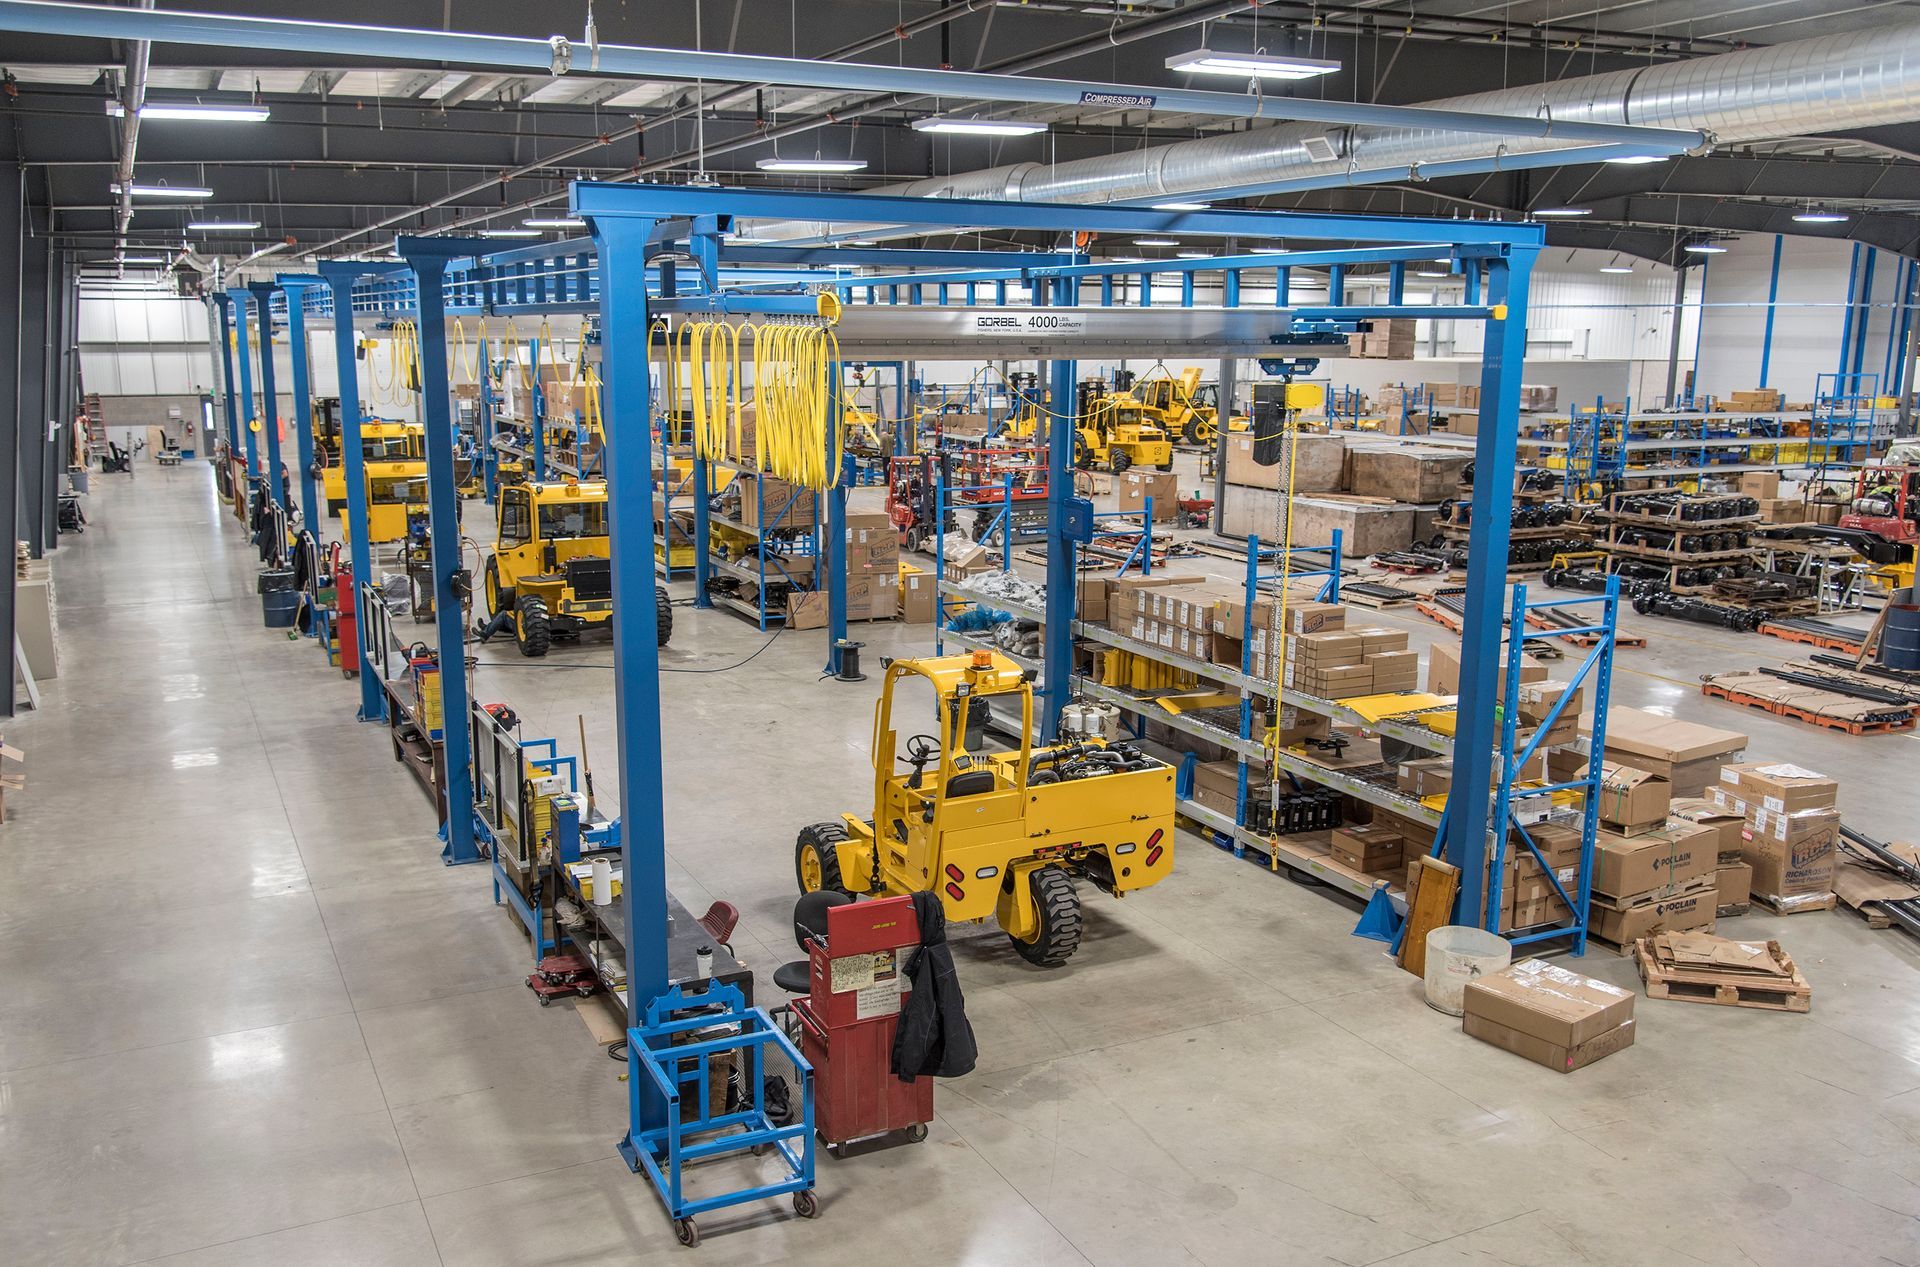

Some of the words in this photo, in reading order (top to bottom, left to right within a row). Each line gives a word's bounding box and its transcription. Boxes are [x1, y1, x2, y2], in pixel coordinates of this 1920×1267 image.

[1084, 93, 1137, 105] COMPRESSED
[1137, 96, 1152, 106] AIR
[977, 317, 1022, 327] GORBEL
[1028, 316, 1058, 328] 4000
[1661, 852, 1691, 867] POCLAIN
[1665, 897, 1698, 912] POCLAIN
